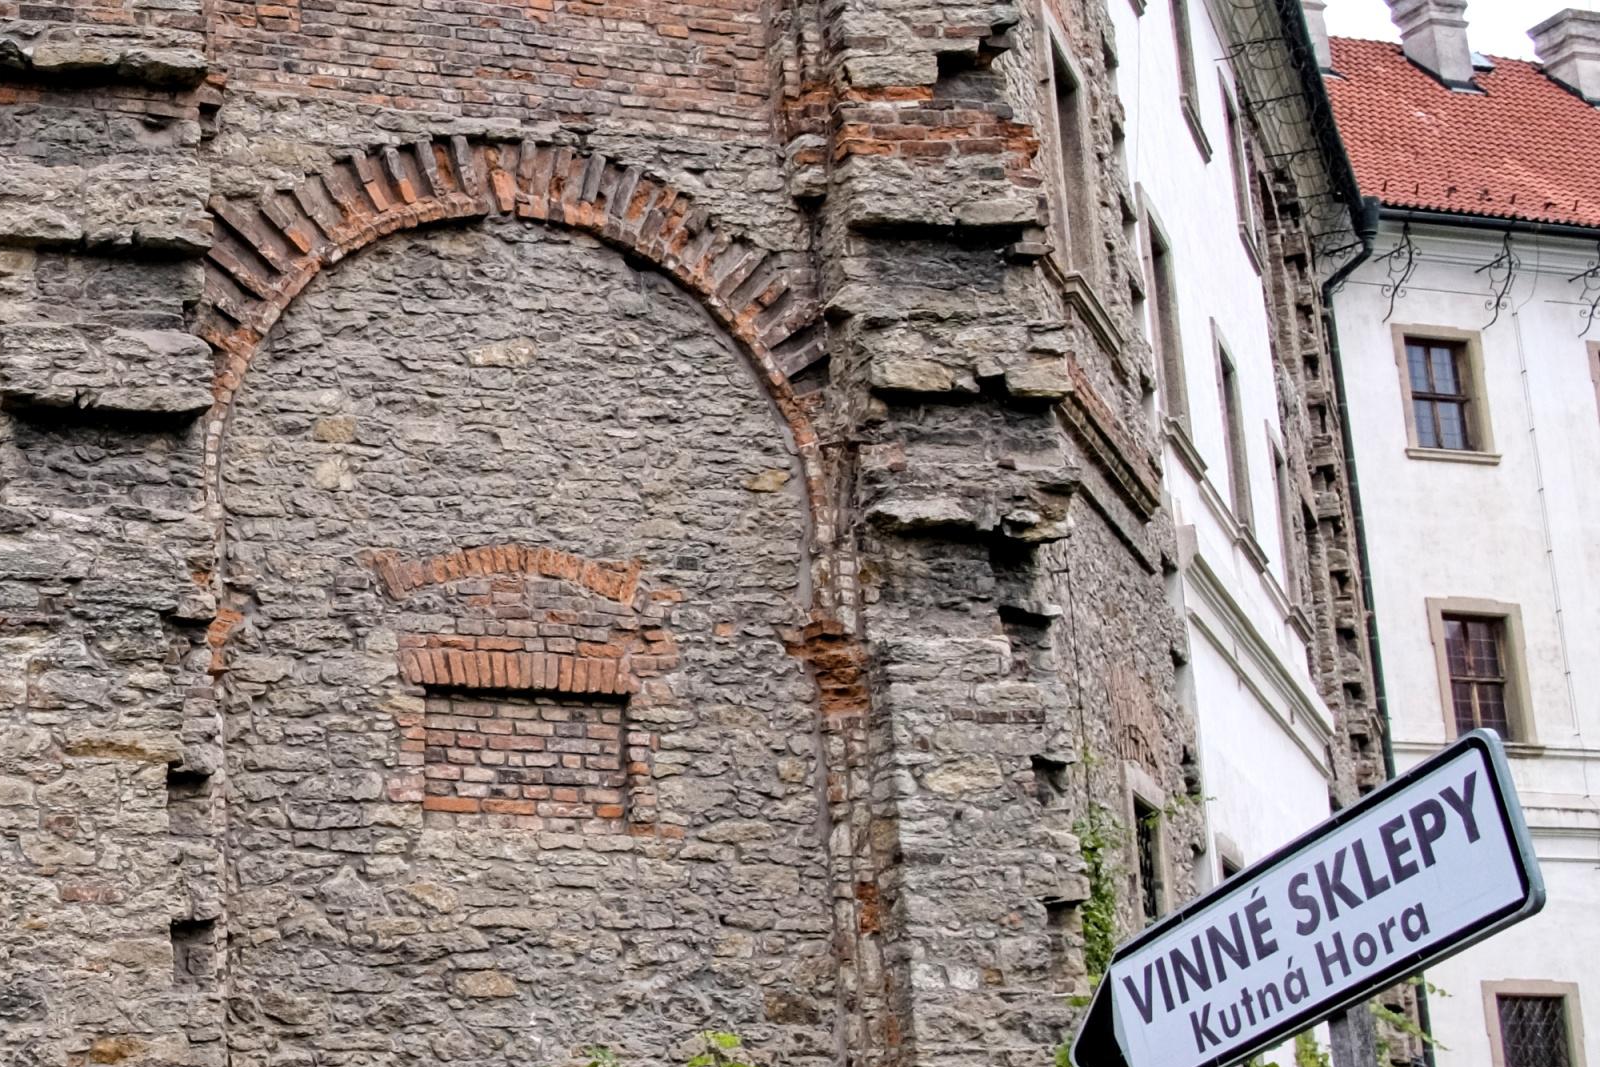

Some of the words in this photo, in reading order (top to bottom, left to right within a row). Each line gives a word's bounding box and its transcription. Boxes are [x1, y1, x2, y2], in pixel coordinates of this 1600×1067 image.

[1122, 887, 1279, 1025] VINNÉ
[1287, 771, 1481, 936] SKLEPY
[1189, 956, 1310, 1053] Kutná
[1315, 903, 1430, 986] Hora
